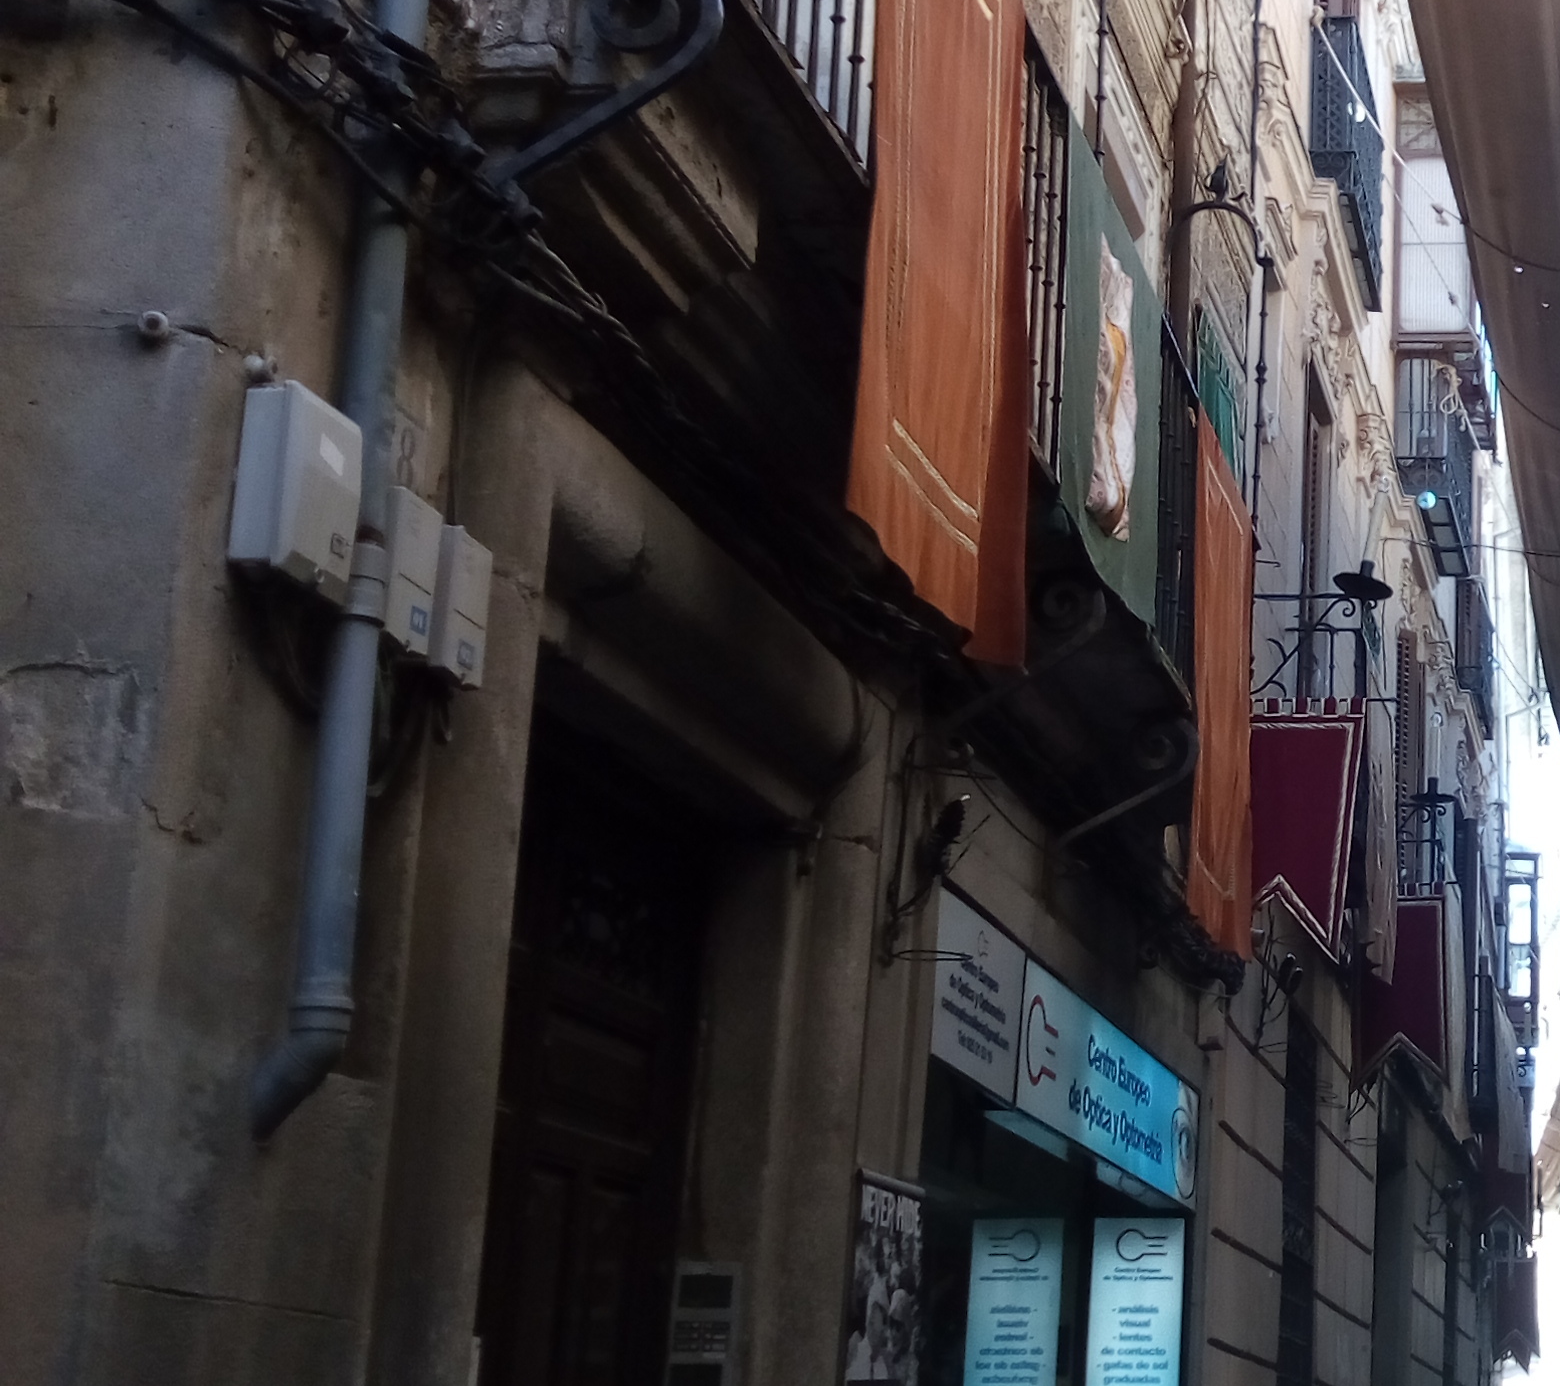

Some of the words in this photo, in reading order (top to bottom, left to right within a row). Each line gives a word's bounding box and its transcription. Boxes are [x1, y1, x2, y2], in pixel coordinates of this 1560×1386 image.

[1088, 1034, 1117, 1083] Centro
[1118, 1056, 1150, 1107] Europeo
[1069, 1077, 1081, 1114] de
[1119, 1318, 1151, 1327] visual
[1119, 1332, 1153, 1342] lentes
[1101, 1346, 1114, 1355] de
[1117, 1346, 1166, 1355] contacto
[1103, 1361, 1133, 1371] gafas
[1136, 1360, 1150, 1370] de
[1152, 1360, 1168, 1370] sol
[1103, 1375, 1161, 1386] graduadas
